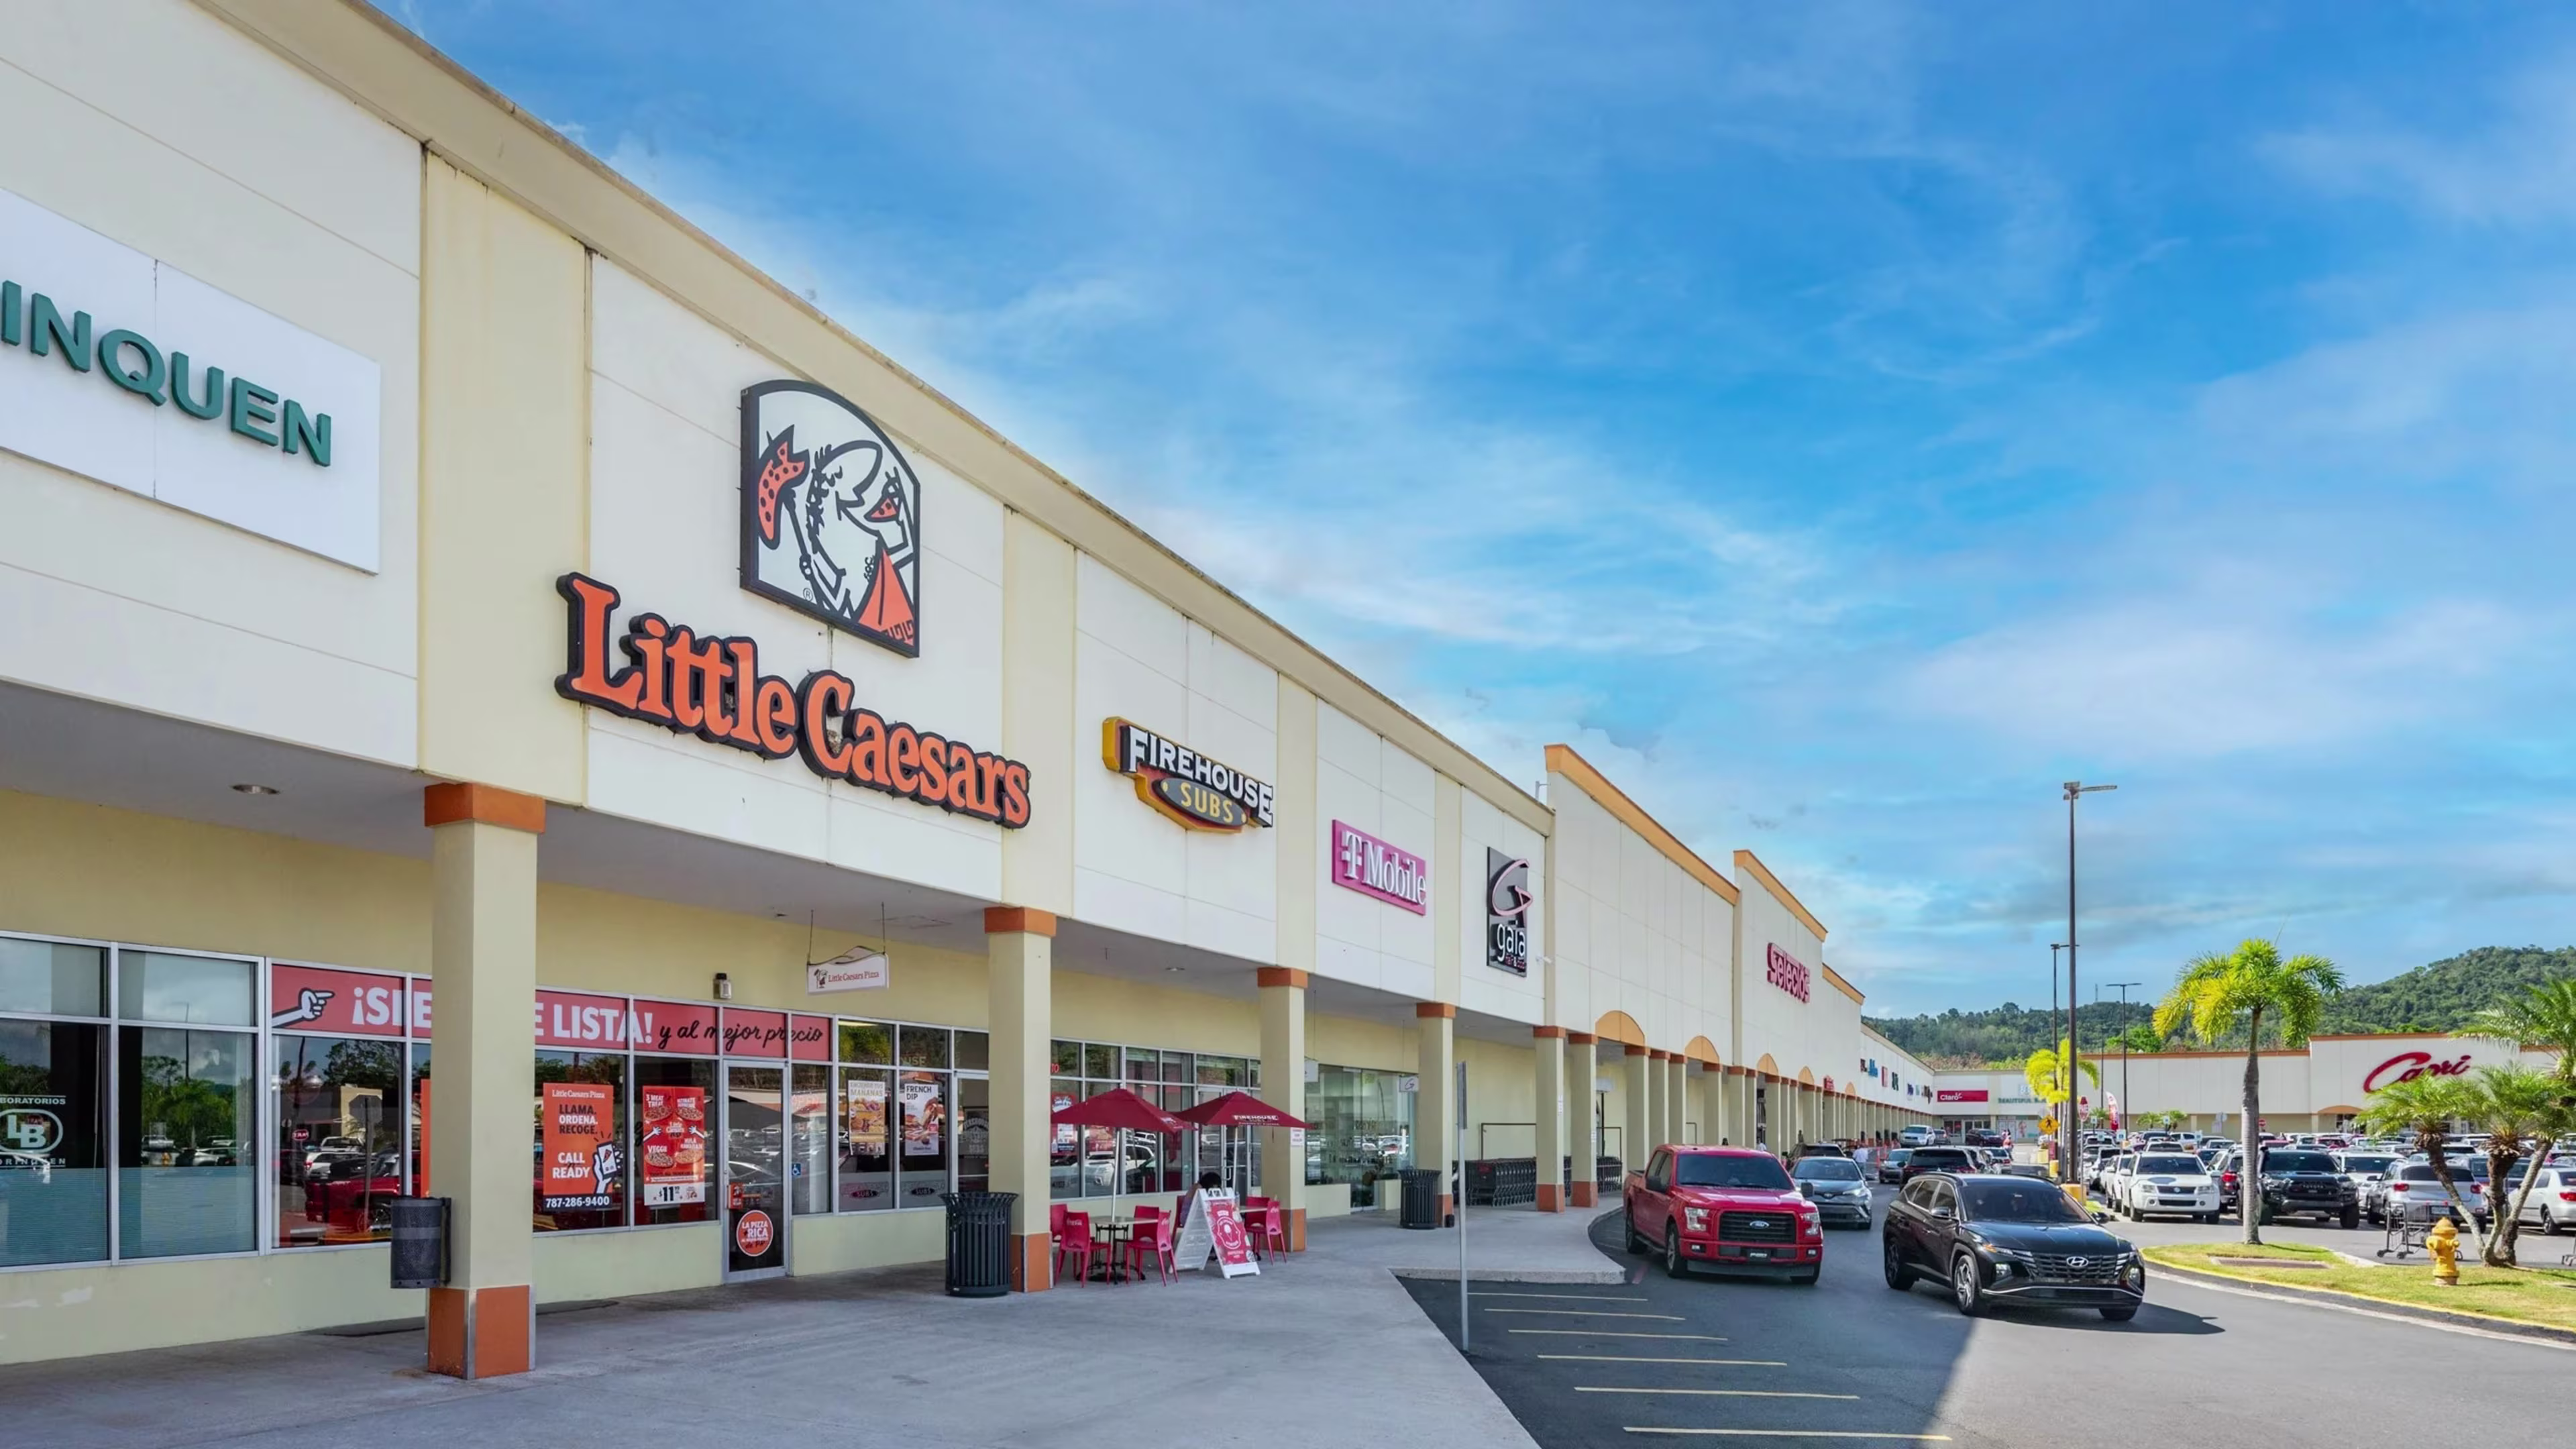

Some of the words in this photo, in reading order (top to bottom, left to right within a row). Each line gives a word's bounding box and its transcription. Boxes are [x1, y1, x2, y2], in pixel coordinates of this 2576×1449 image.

[2, 280, 331, 467] INQUEN
[558, 574, 797, 757] Little
[800, 672, 1030, 827] Caesars
[1128, 725, 1273, 827] FIREHOUSE
[1180, 782, 1234, 823] SUBS
[828, 973, 842, 982] Little
[843, 972, 863, 981] Caesars
[864, 971, 879, 979] Pizza
[553, 1004, 653, 1044] LISTA!
[658, 1024, 672, 1050] y
[677, 1020, 698, 1039] al
[704, 1023, 761, 1051] mejor
[763, 1024, 823, 1049] precio
[552, 1089, 567, 1097] Little
[568, 1090, 590, 1098] Caesars
[590, 1091, 605, 1099] Pizza
[906, 1085, 932, 1093] FRENCH
[559, 1104, 596, 1114] LLAMA.
[559, 1115, 598, 1125] ORDENA.
[7, 1114, 47, 1148] LB
[559, 1125, 598, 1134] RECOGE.
[557, 1152, 585, 1163] CALL
[552, 1167, 590, 1179] READY
[545, 1196, 610, 1208] 787-286-9400
[747, 1228, 768, 1238] RICA
